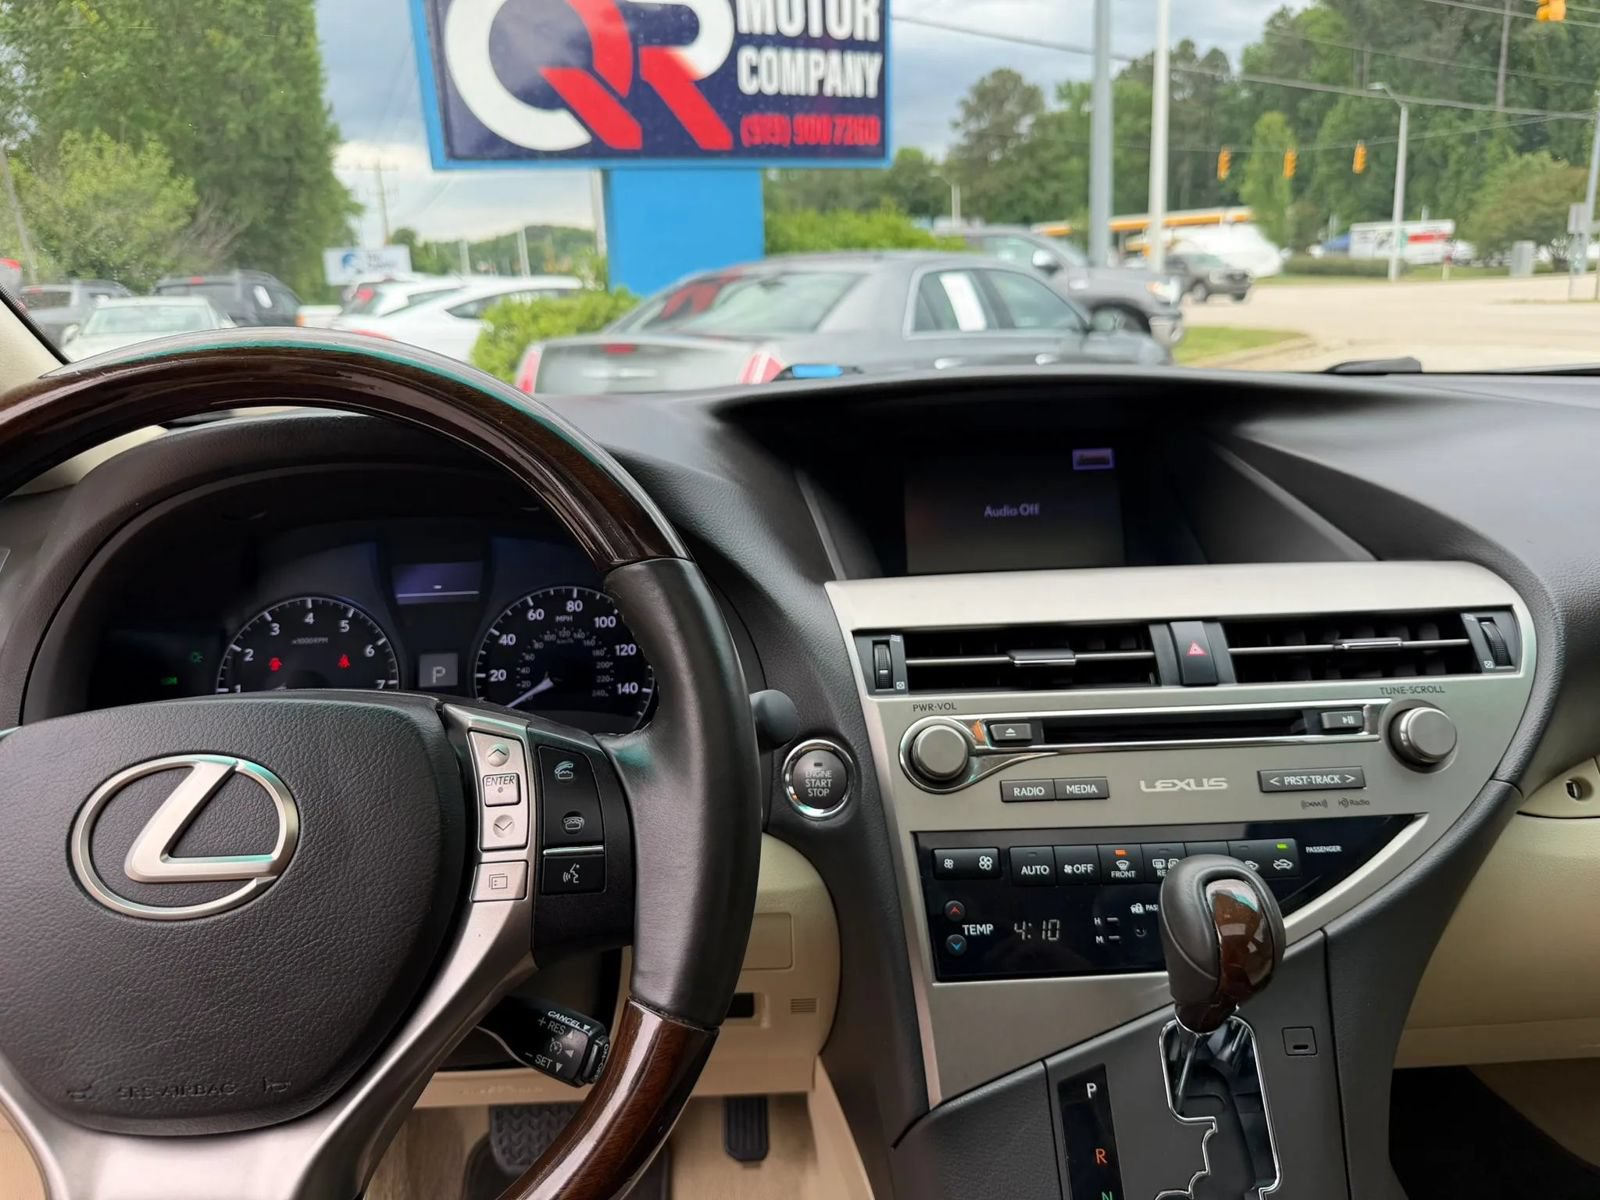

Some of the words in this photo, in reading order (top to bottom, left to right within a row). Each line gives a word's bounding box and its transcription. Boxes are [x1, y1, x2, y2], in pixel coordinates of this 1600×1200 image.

[737, 0, 880, 41] MOTOR
[737, 45, 883, 98] COMPANY
[984, 505, 1018, 517] Audio
[1019, 503, 1040, 516] Off
[566, 600, 583, 612] 80
[304, 612, 315, 624] 4
[528, 609, 545, 621] 60
[340, 620, 350, 632] 5
[594, 616, 616, 628] 100
[270, 624, 280, 636] 3
[499, 633, 516, 646] 40
[243, 649, 254, 661] 2
[365, 645, 375, 657] 6
[615, 644, 637, 656] 120
[433, 666, 446, 684] P
[489, 669, 507, 682] 20
[377, 680, 386, 690] 7
[617, 683, 638, 695] 140
[805, 769, 832, 779] ENGINE
[485, 774, 515, 787] ENTER
[805, 778, 832, 788] START
[1139, 777, 1229, 793] LEXUS
[808, 788, 830, 797] STOP
[1014, 786, 1045, 796] RADIO
[1066, 784, 1098, 795] MEDIA
[1306, 845, 1342, 853] PASSENGER
[1021, 865, 1050, 876] AUTO
[1073, 863, 1094, 873] OFF
[1111, 869, 1136, 879] FRONT
[962, 923, 994, 936] TEMP
[1014, 918, 1061, 941] 4:10
[548, 1010, 581, 1029] CANCEL
[547, 1021, 565, 1035] RES
[535, 1054, 553, 1069] SET
[1086, 1082, 1098, 1099] P
[1095, 1147, 1108, 1164] R
